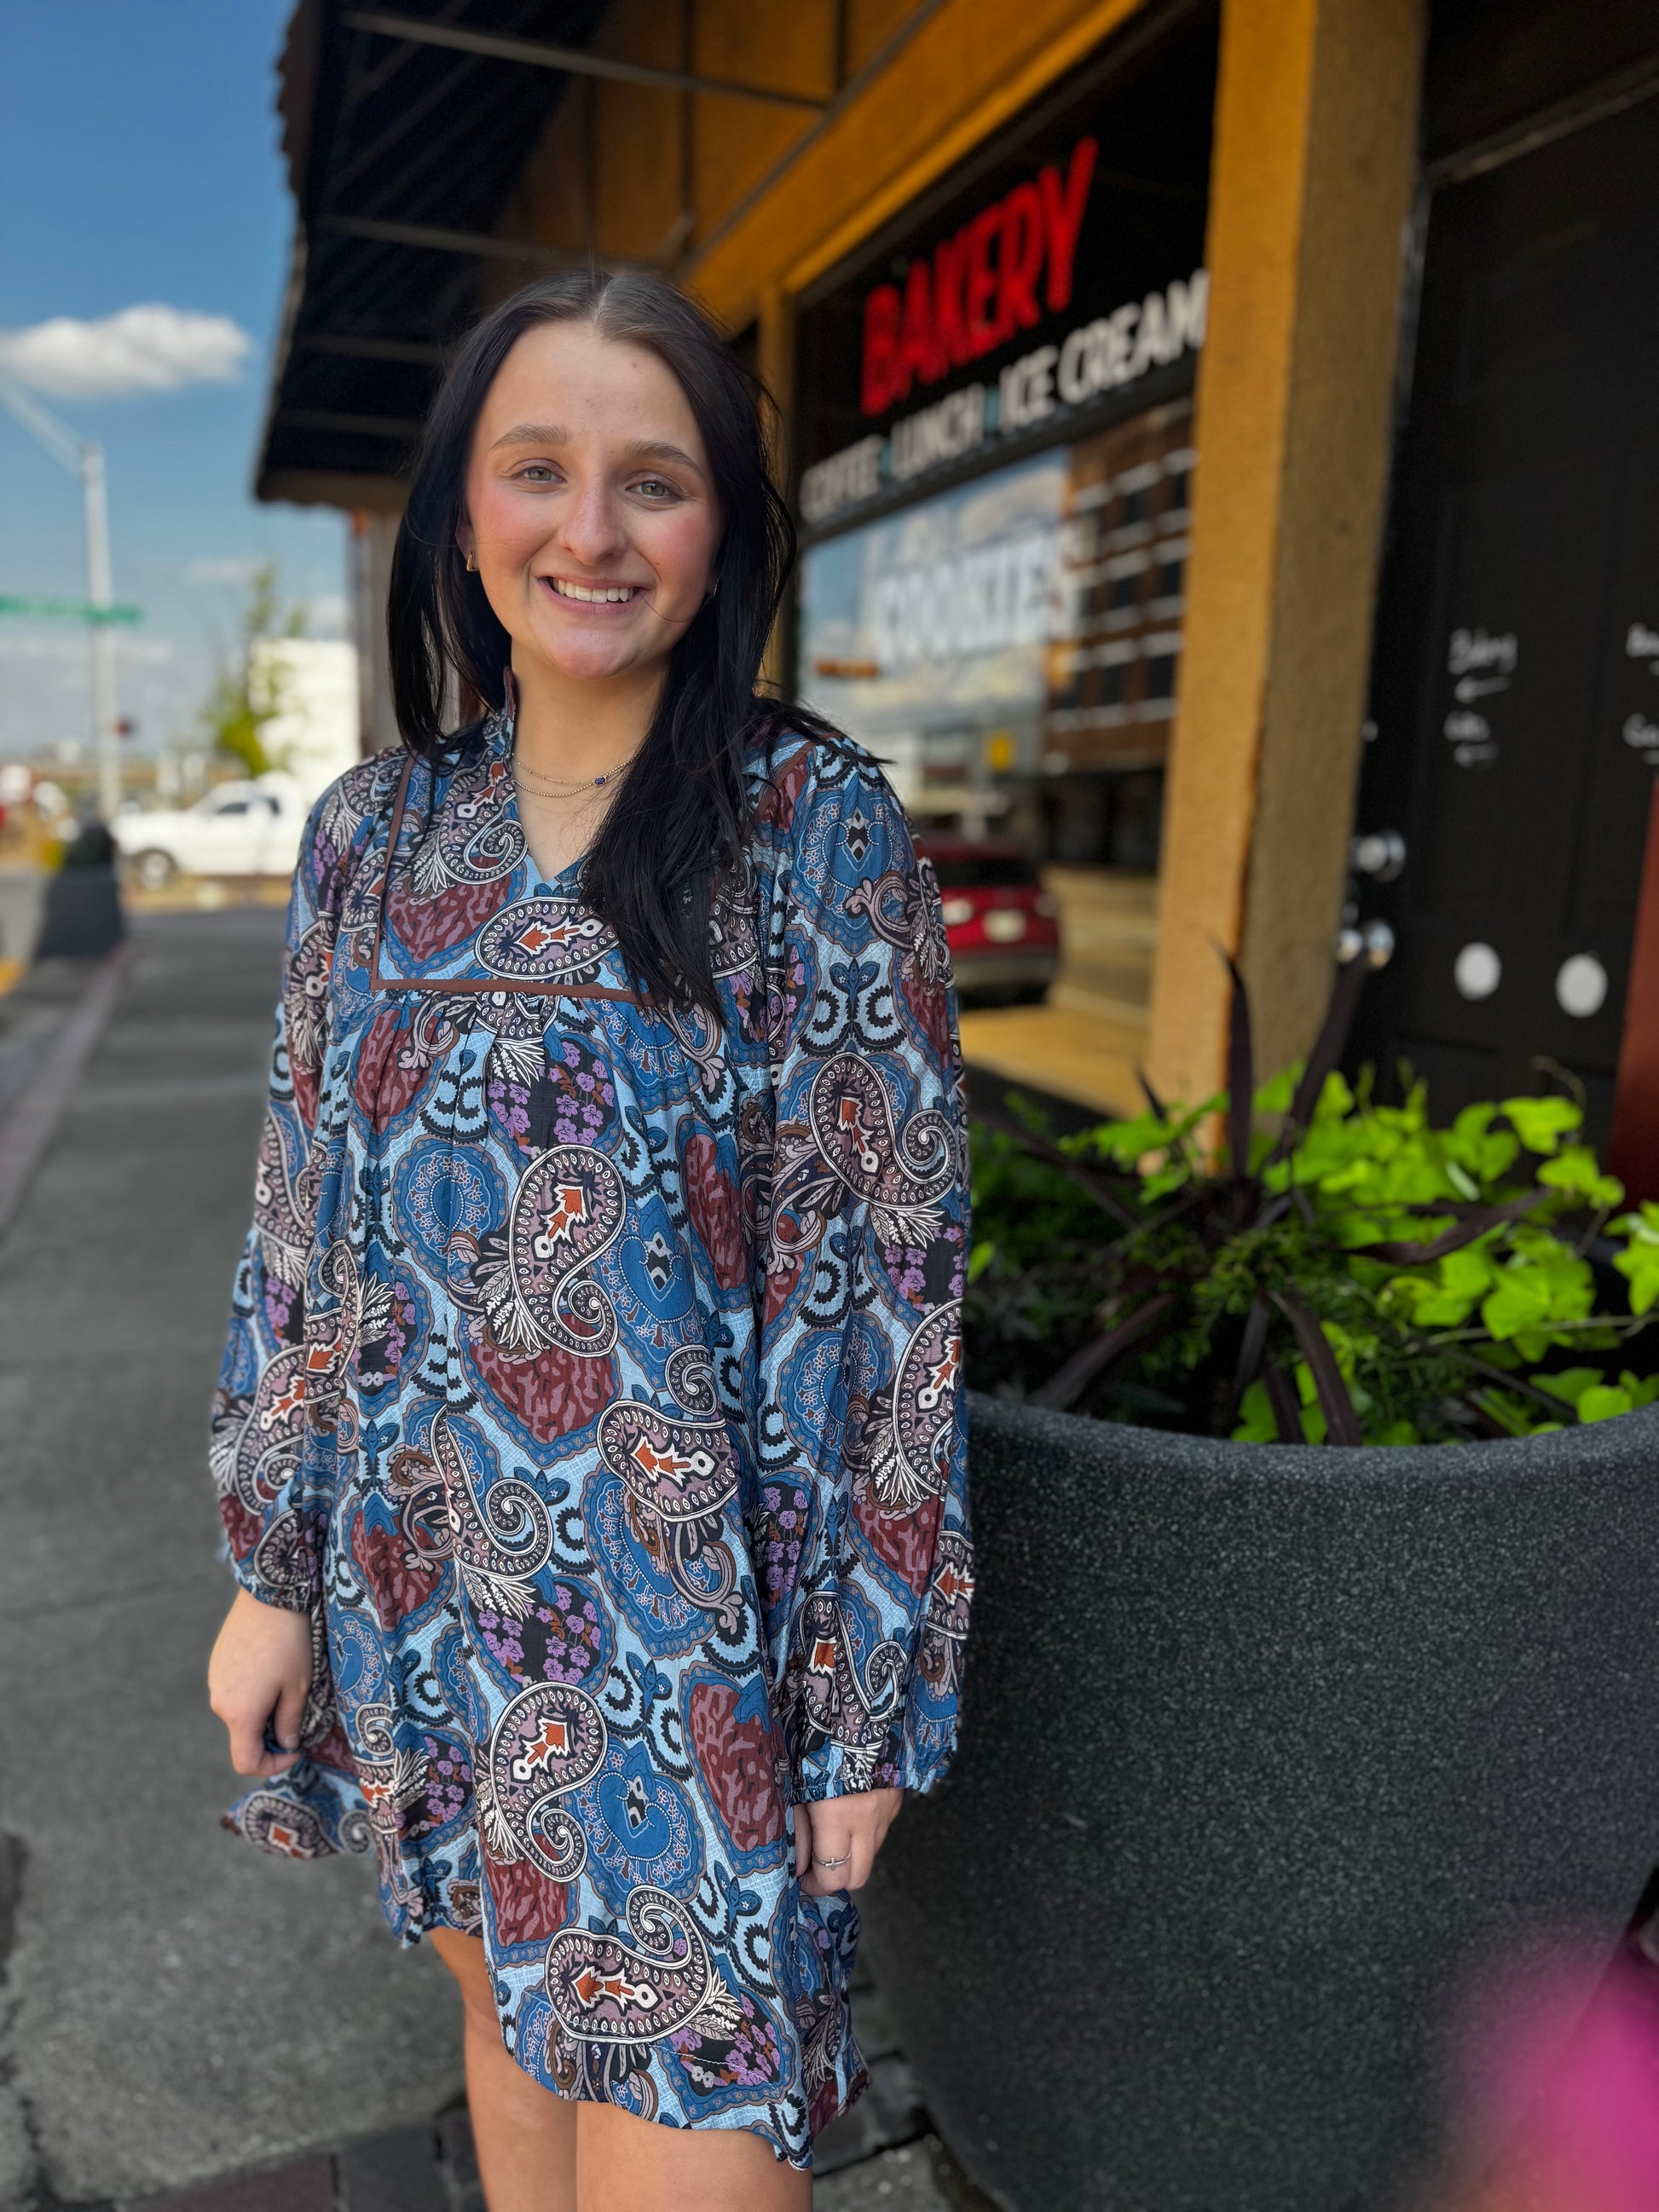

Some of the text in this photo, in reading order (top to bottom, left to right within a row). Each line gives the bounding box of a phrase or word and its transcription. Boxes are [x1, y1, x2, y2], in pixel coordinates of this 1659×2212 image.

[800, 269, 1210, 522] COFFEE LUNCH ICE CREAM
[861, 136, 1099, 417] BAKERY
